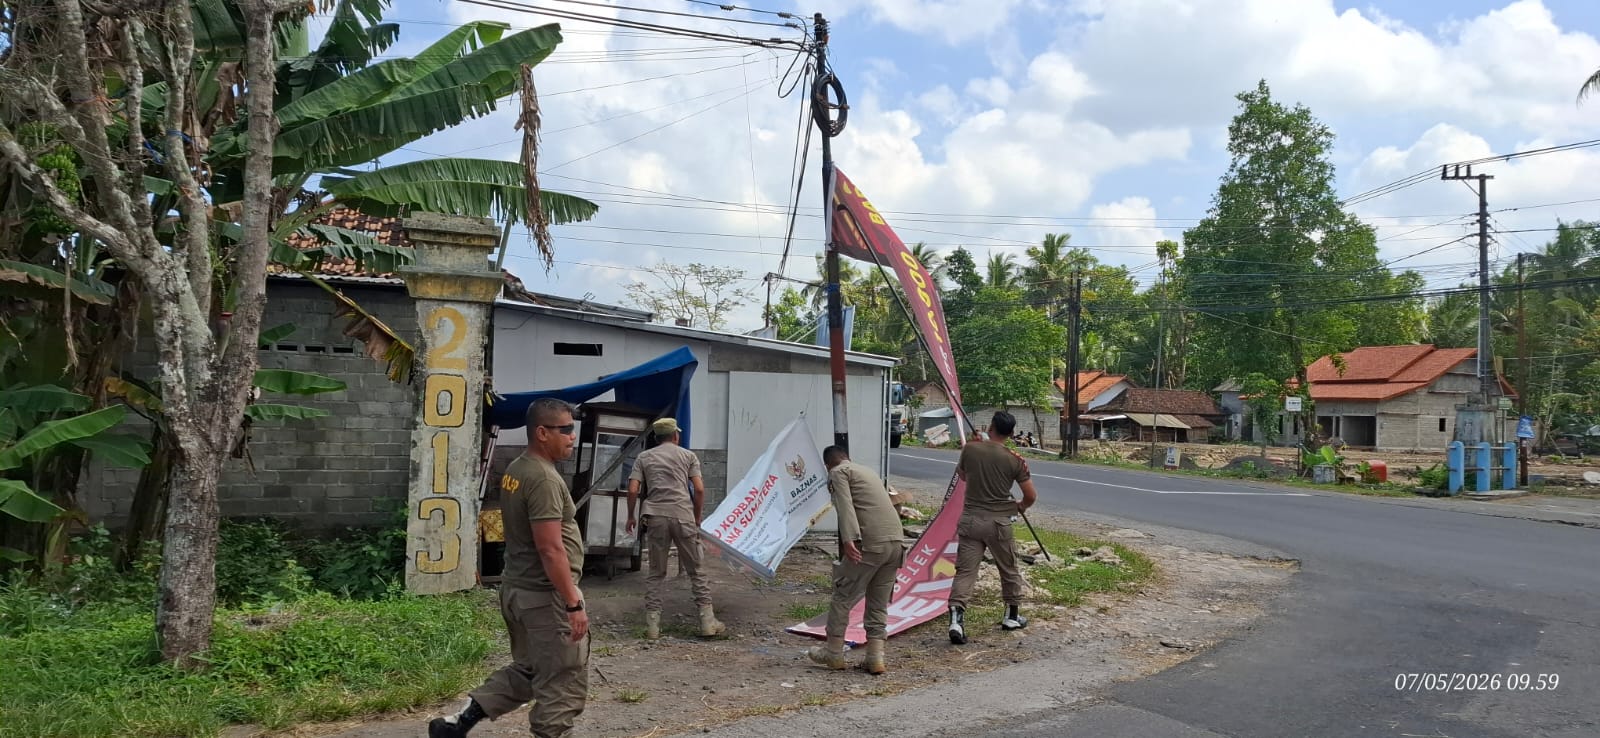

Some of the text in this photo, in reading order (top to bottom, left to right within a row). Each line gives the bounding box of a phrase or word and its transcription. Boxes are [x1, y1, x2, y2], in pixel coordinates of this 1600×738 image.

[415, 306, 468, 574] 2013
[720, 487, 759, 531] KORBAN
[740, 474, 779, 527] SUMATERA
[790, 474, 818, 498] BAZNAS
